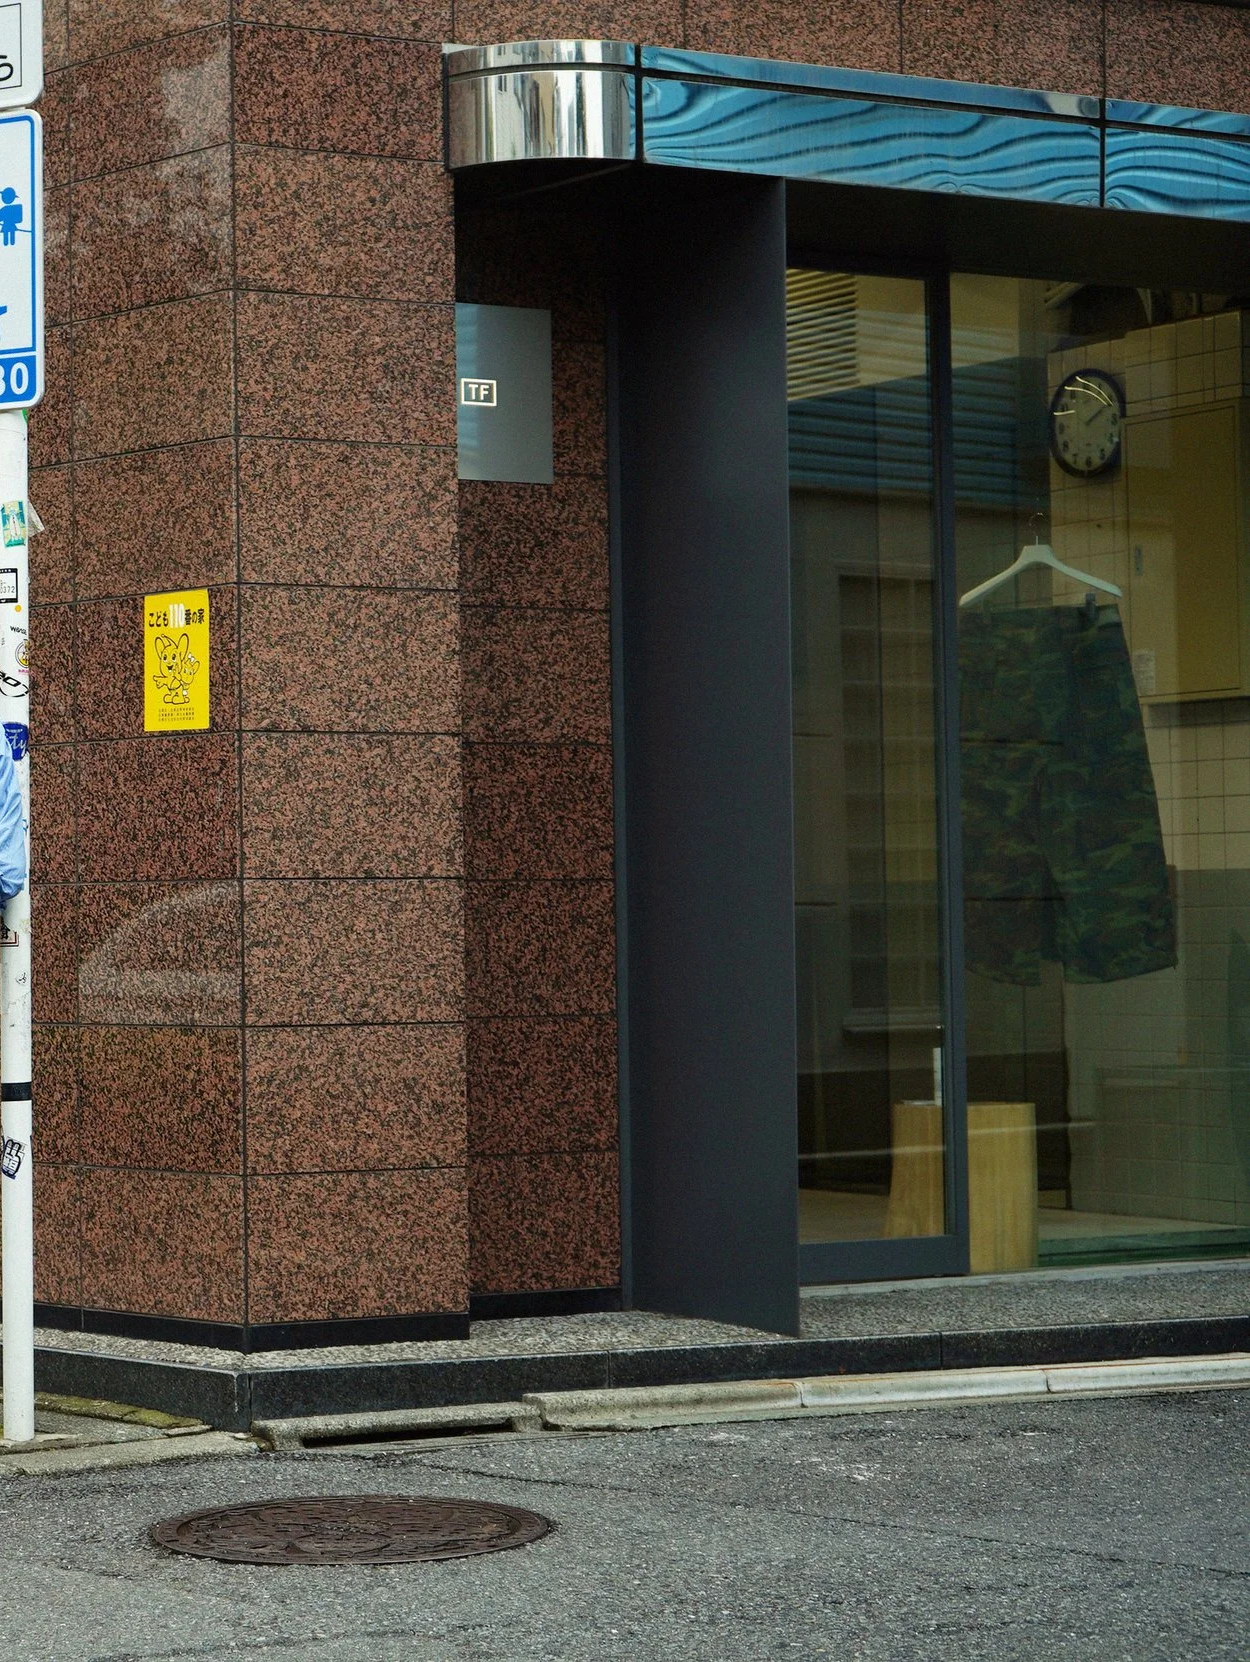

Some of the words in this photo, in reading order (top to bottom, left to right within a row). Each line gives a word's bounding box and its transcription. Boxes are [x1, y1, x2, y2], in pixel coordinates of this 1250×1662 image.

[468, 383, 490, 400] TF
[148, 603, 205, 629] こども110番の家
